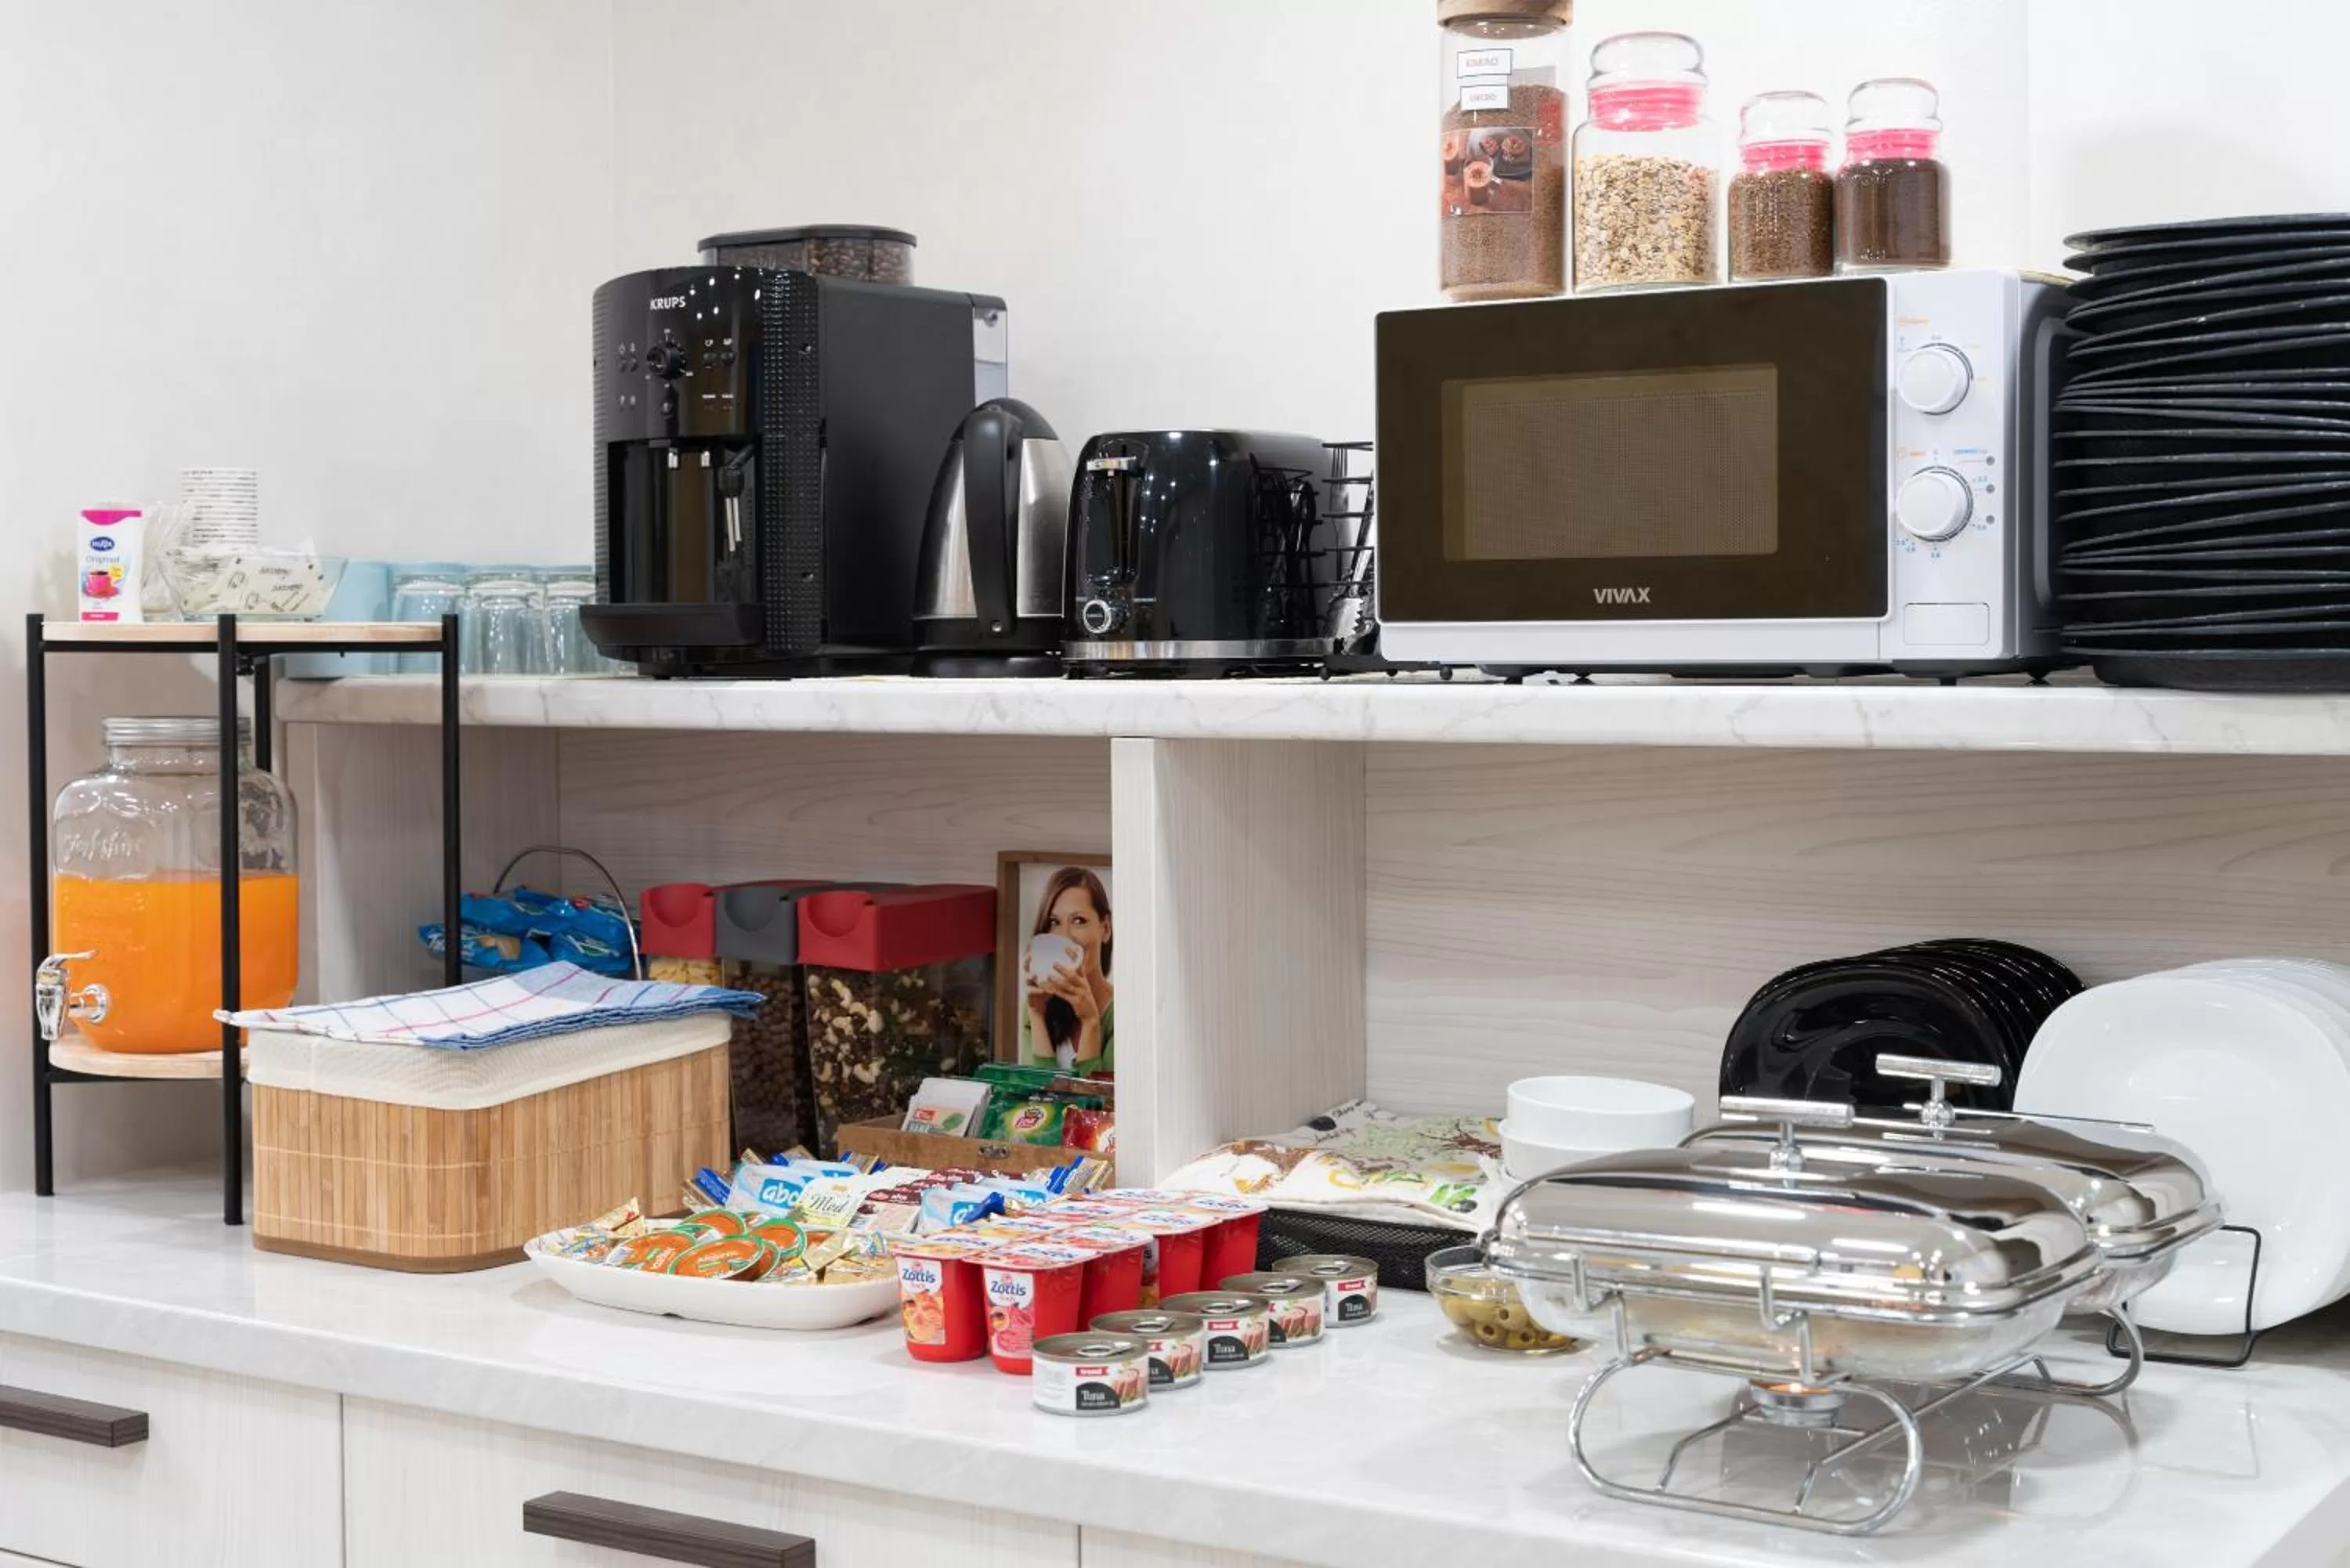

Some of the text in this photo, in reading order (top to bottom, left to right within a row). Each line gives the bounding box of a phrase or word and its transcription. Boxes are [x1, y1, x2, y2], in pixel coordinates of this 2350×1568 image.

[649, 295, 686, 310] KRUPS
[1593, 587, 1651, 604] VIVAX
[902, 1267, 936, 1284] Zottis
[990, 1281, 1028, 1297] Zottis
